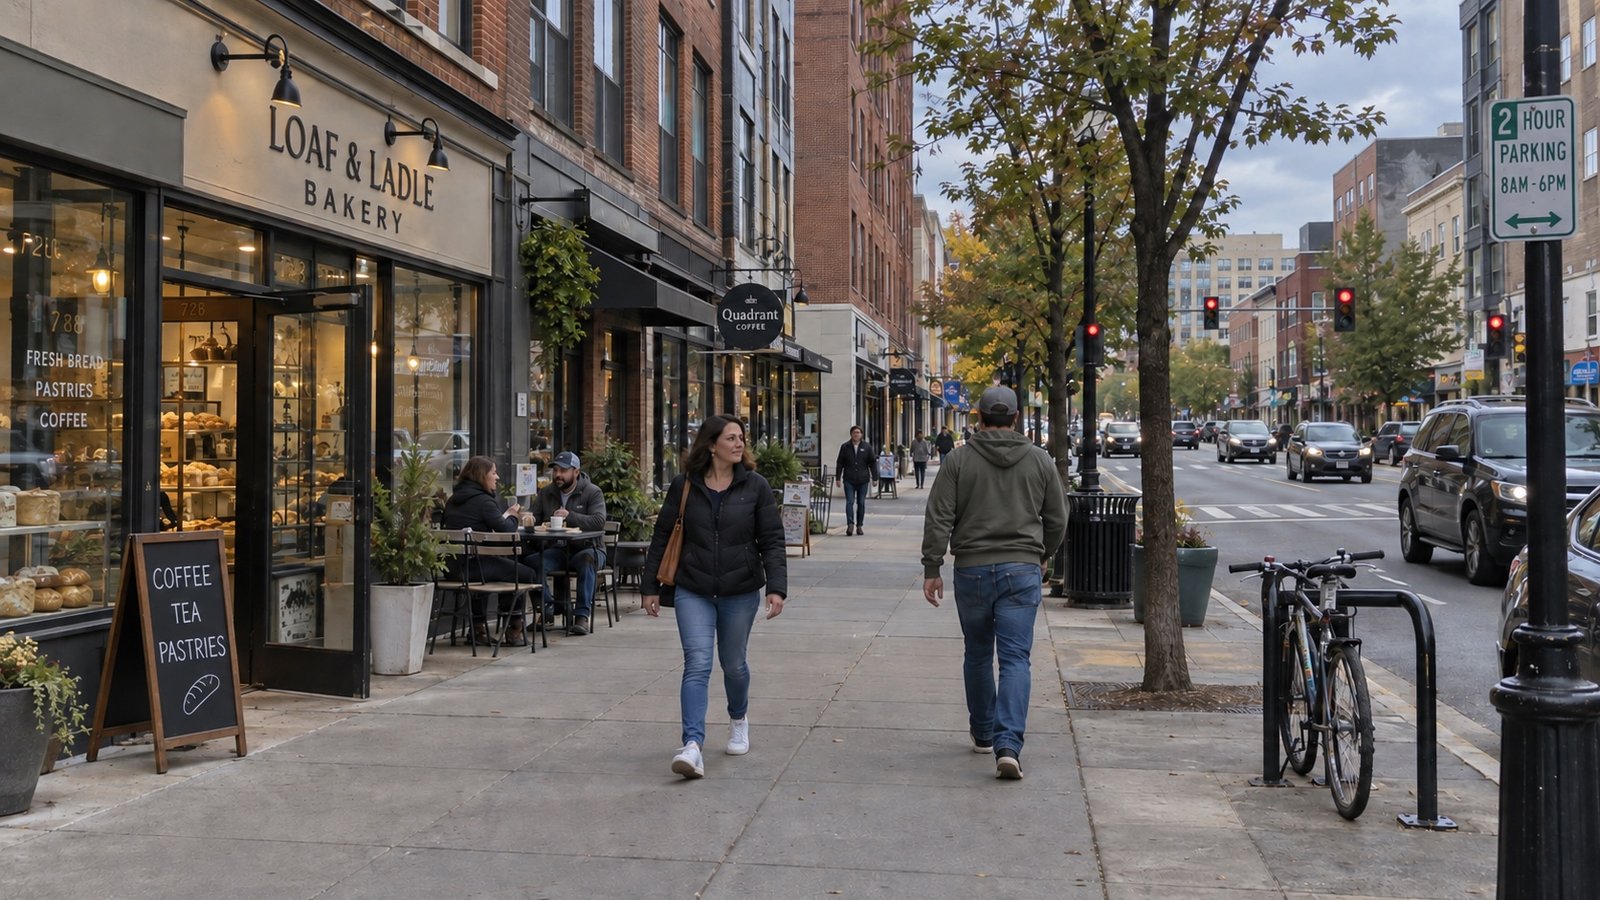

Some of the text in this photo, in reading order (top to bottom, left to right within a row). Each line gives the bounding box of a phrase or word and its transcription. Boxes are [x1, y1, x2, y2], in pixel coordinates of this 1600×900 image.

[1498, 107, 1566, 135] 2 HOUR
[269, 105, 434, 211] LOAF & LADLE
[1500, 141, 1567, 164] PARKING
[304, 178, 402, 234] BAKERY
[51, 310, 83, 334] 788
[722, 308, 779, 323] Quadrant
[735, 323, 766, 331] COFFEE
[26, 349, 104, 370] FRESH BREAD
[35, 380, 94, 398] PASTRIES
[39, 412, 88, 428] COFFEE
[152, 564, 213, 590] COFFEE
[171, 601, 202, 624] TEA
[158, 635, 226, 664] PASTRIES
